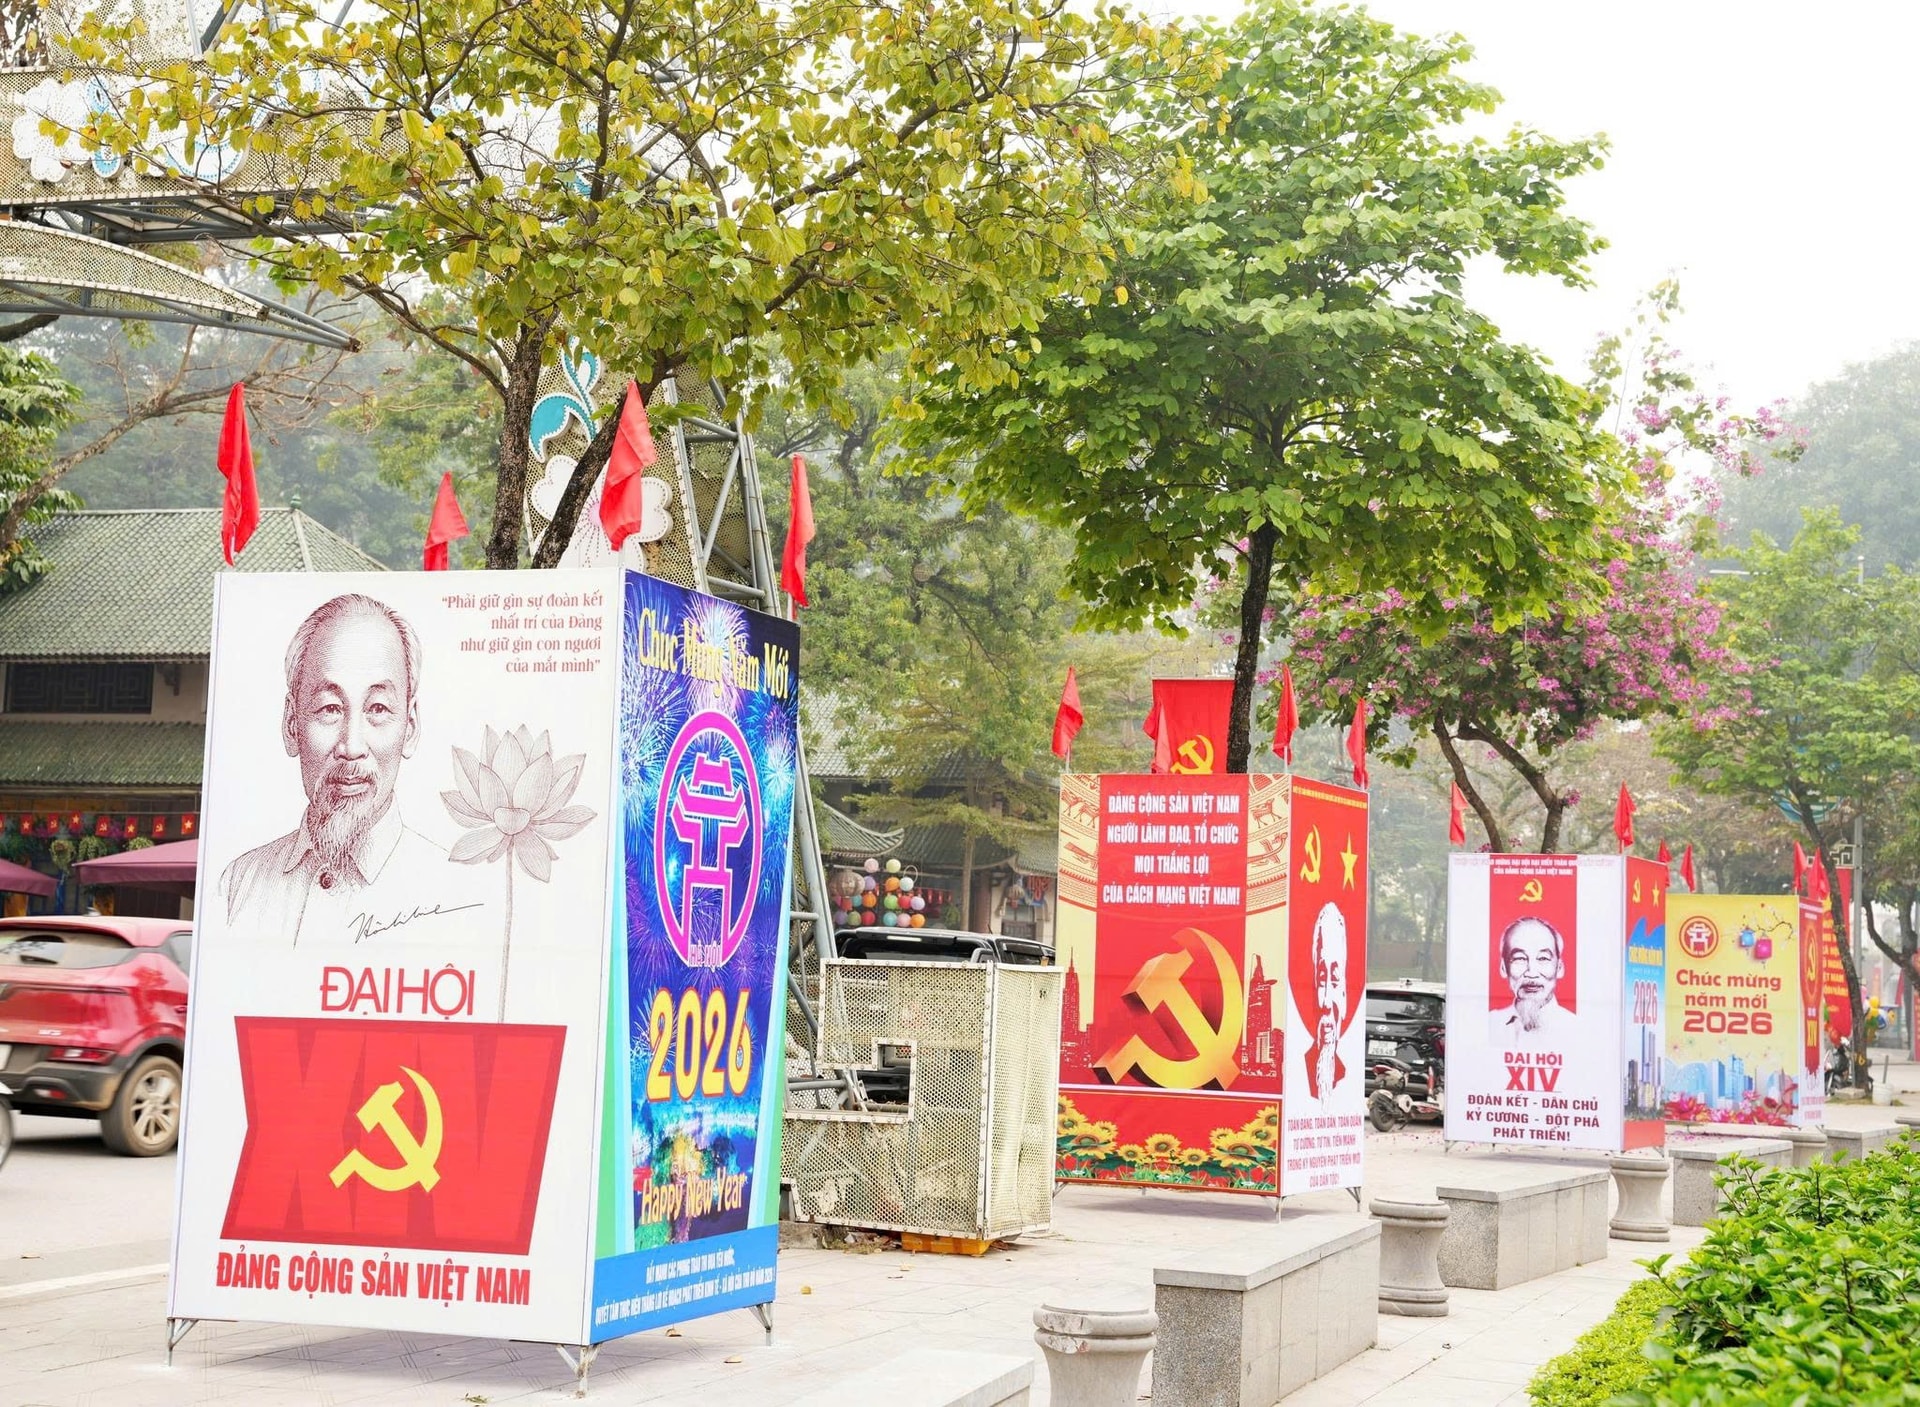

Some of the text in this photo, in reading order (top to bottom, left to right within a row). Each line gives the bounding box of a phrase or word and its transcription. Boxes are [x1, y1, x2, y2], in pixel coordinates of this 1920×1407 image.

[480, 594, 500, 610] giữ
[503, 593, 522, 610] gìn
[527, 595, 544, 611] sự
[547, 593, 578, 607] đoàn
[583, 590, 603, 607] kết
[492, 613, 602, 631] nhất trí của Đảng
[460, 638, 486, 651] như
[489, 637, 509, 654] giữ
[512, 636, 532, 653] gìn
[537, 639, 560, 651] con
[639, 607, 789, 699] Chúc Mừng Năm Mới
[506, 657, 528, 672] của
[533, 655, 557, 672] mắt
[1108, 791, 1239, 816] ĐẢNG CỘNG SẢN VIỆT NAM
[1107, 820, 1239, 847] NGƯỜI LÃNH ĐẠO, TỔ CHỨC
[1135, 851, 1209, 877] MỌI THẮNG LỢI
[1103, 882, 1240, 907] CỦA CÁCH MẠNG VIỆT NAM!
[320, 963, 475, 1020] ĐẠI HỘI
[1676, 969, 1781, 991] Chúc mừng
[1633, 980, 1657, 1025] 2026
[1685, 992, 1767, 1009] năm mới
[1684, 1010, 1772, 1035] 2026
[647, 987, 751, 1103] 2026
[1504, 1051, 1562, 1068] ĐẠI HỘI
[1505, 1066, 1561, 1092] XIV
[1468, 1094, 1502, 1105] ĐOÀN
[1507, 1093, 1528, 1107] KẾT
[1573, 1096, 1598, 1111] CHỦ
[1466, 1107, 1482, 1121] KỶ
[1487, 1111, 1528, 1123] CƯƠNG
[1546, 1114, 1569, 1127] ĐỘT
[1574, 1116, 1599, 1128] PHÁ
[1494, 1126, 1570, 1141] PHÁT TRIỂN!
[641, 1166, 746, 1225] Happy New Year
[216, 1245, 531, 1308] ĐẢNG CỘNG SẢN VIỆT NAM
